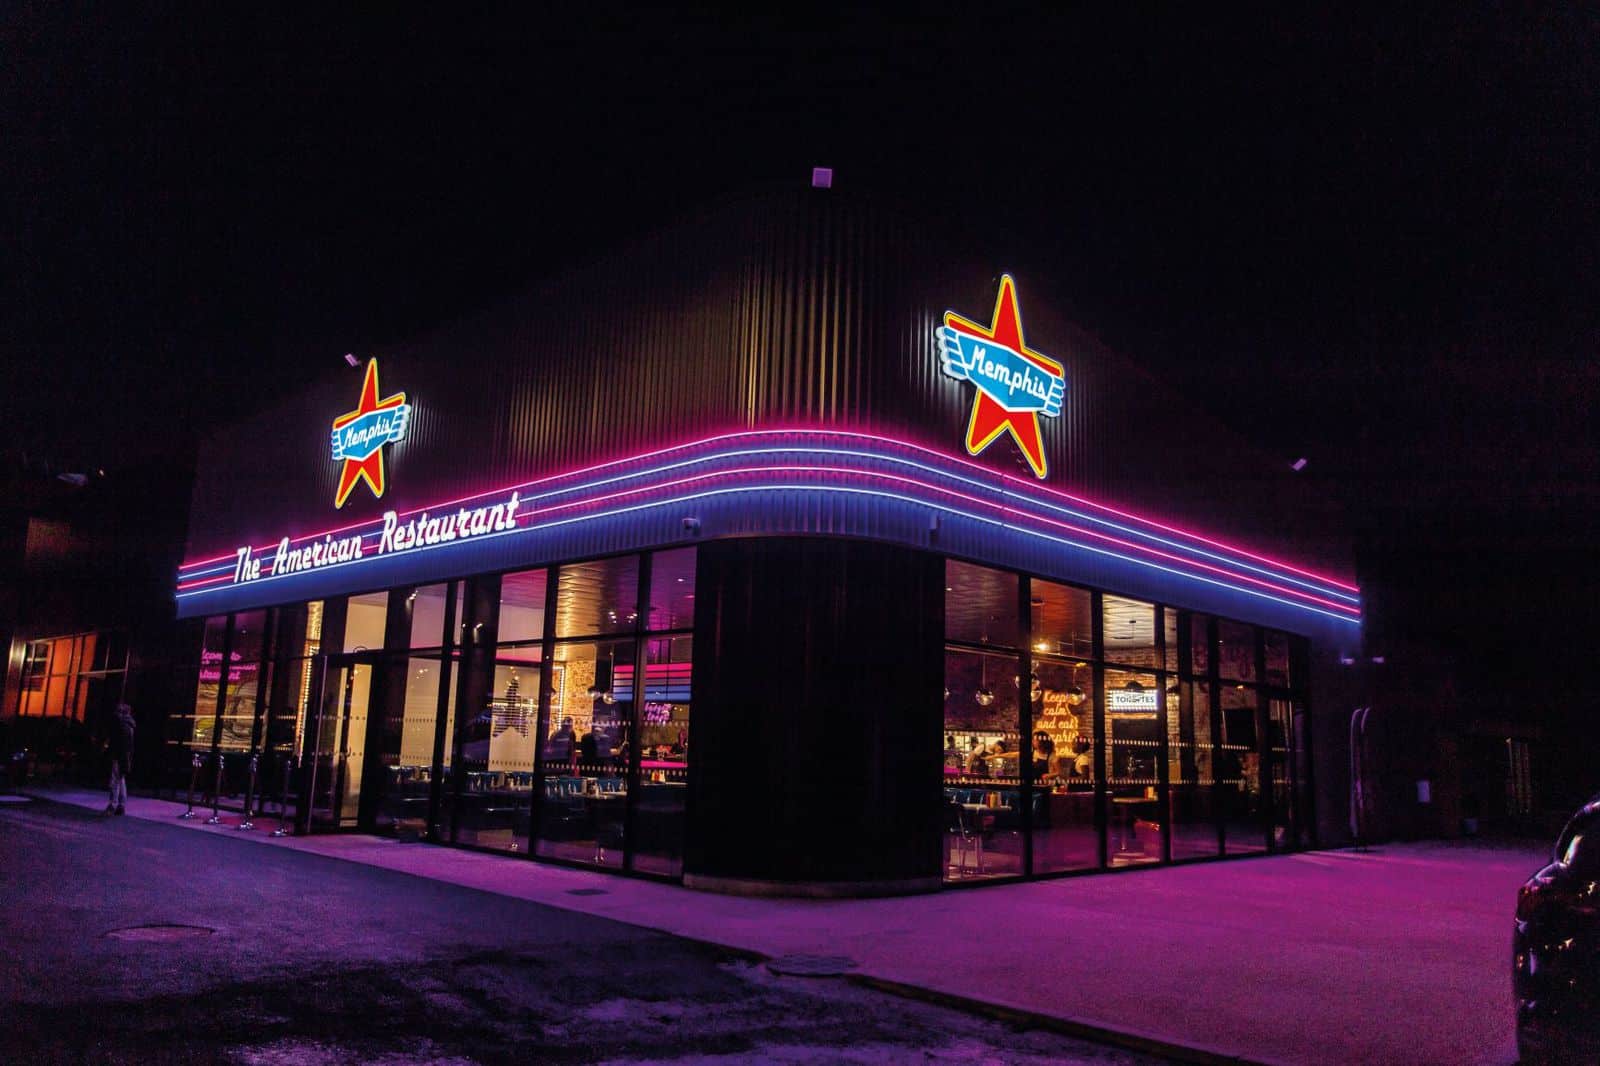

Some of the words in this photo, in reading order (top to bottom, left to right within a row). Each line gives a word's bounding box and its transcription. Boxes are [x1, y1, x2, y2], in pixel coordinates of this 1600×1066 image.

[967, 345, 1047, 398] Memphis
[341, 416, 391, 449] Memphis
[234, 545, 261, 584] The
[271, 534, 363, 576] American
[378, 491, 520, 554] Restaurant
